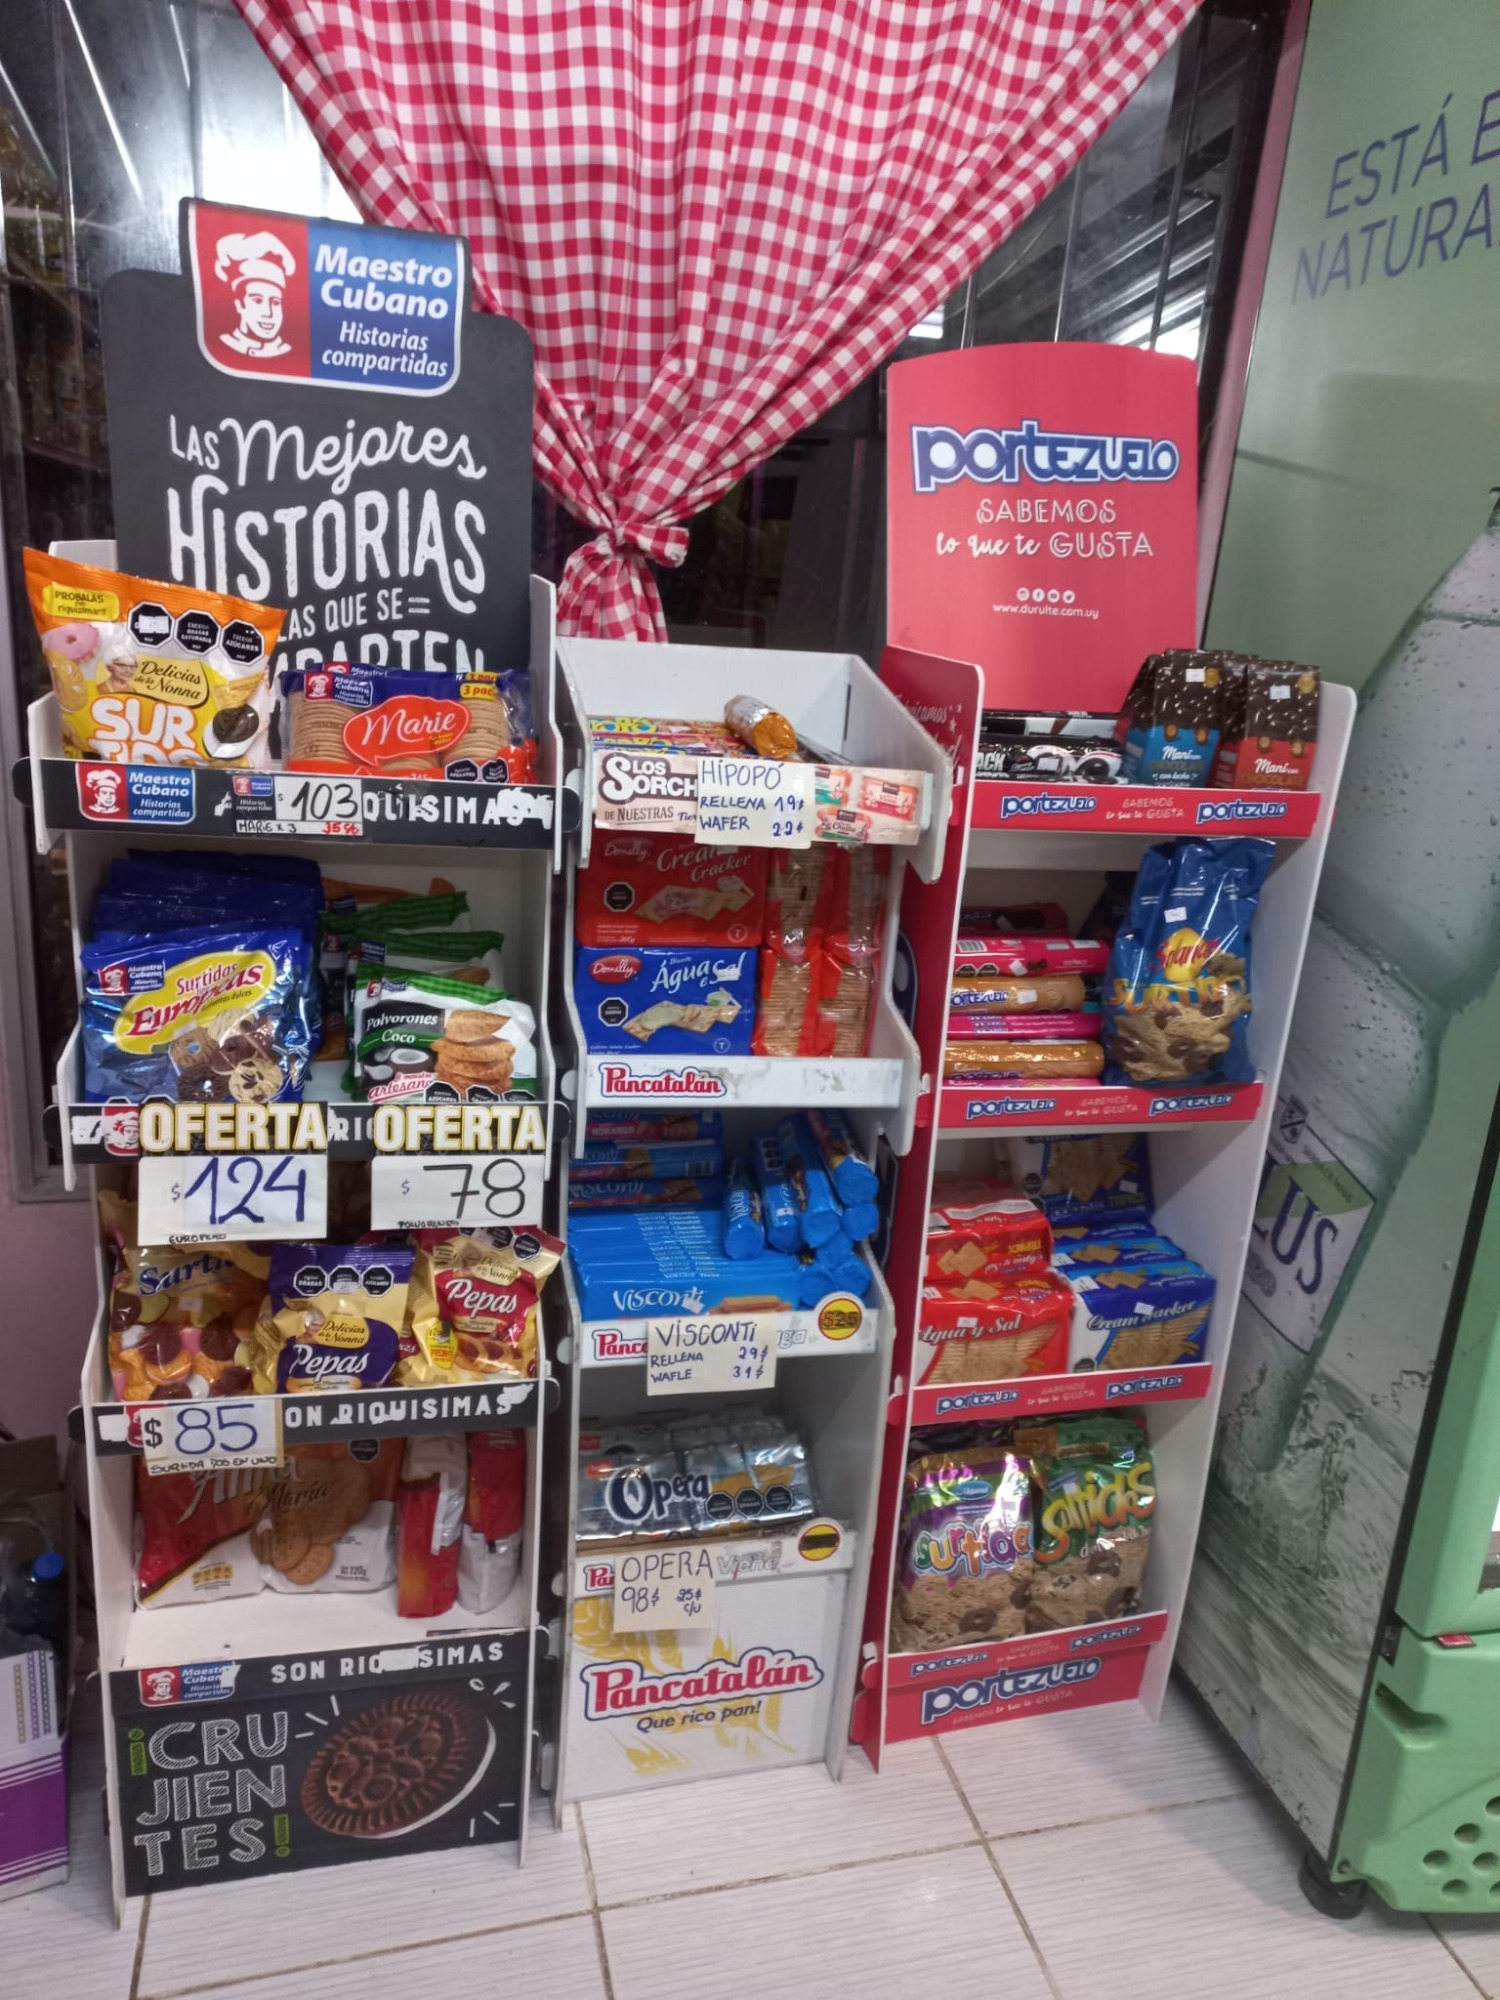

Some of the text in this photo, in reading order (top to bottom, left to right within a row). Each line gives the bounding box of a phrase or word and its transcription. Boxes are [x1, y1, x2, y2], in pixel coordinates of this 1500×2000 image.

[1326, 92, 1453, 219] ESTÁ
[1292, 183, 1500, 305] NATURA
[315, 244, 452, 288] Maestro
[321, 278, 449, 319] Cubano
[339, 320, 428, 351] Historias
[322, 349, 448, 377] compartidas
[170, 414, 487, 495] LAS Mejores
[977, 498, 1116, 524] SABEMOS
[167, 474, 487, 614] HISTORIAS
[936, 531, 1153, 559] lo que te GUSTA
[54, 590, 105, 604] PROBALAS
[325, 593, 367, 632] QUE
[377, 588, 403, 620] SE
[140, 660, 202, 685] Delicias
[147, 677, 201, 700] Nonna
[91, 698, 196, 749] SUR
[361, 708, 456, 746] Marie
[1162, 745, 1191, 761] Maní
[1255, 758, 1288, 774] Maní
[129, 772, 191, 786] Maestro
[132, 784, 190, 797] Cubano
[133, 808, 191, 819] compartidas
[140, 798, 181, 809] Historias
[291, 781, 358, 821] 103
[617, 805, 674, 822] NUESTRAS
[700, 795, 765, 811] RELLENA
[287, 824, 297, 833] 3
[700, 815, 750, 831] WAFER
[691, 854, 751, 881] Cracker
[177, 963, 237, 996] Surtidas
[651, 959, 709, 994] Água
[366, 1011, 438, 1032] Polvorones
[381, 1030, 416, 1043] Coco
[604, 1067, 722, 1095] Pancatalán
[138, 1103, 327, 1151] OFERTA
[374, 1105, 546, 1151] OFERTA
[171, 1155, 306, 1225] $ 124
[400, 1158, 526, 1219] $ 78
[445, 1278, 518, 1319] Pepas
[613, 1286, 704, 1311] Visconti
[323, 1320, 366, 1334] Delicias
[656, 1319, 757, 1347] VISCONTI
[988, 1313, 1022, 1333] Sal
[1086, 1313, 1139, 1331] Cream
[332, 1332, 364, 1343] Nonna
[289, 1344, 370, 1382] Pepas
[651, 1351, 704, 1368] RELLENA
[651, 1369, 692, 1383] WAFLE
[144, 1403, 258, 1455] $ 85
[621, 1549, 713, 1582] OPERA
[271, 1662, 325, 1684] SON
[591, 1654, 814, 1713] Pancatalán
[637, 1700, 762, 1733] Que rico pan!
[136, 1765, 286, 1825] JIEN
[134, 1814, 291, 1876] TES!
